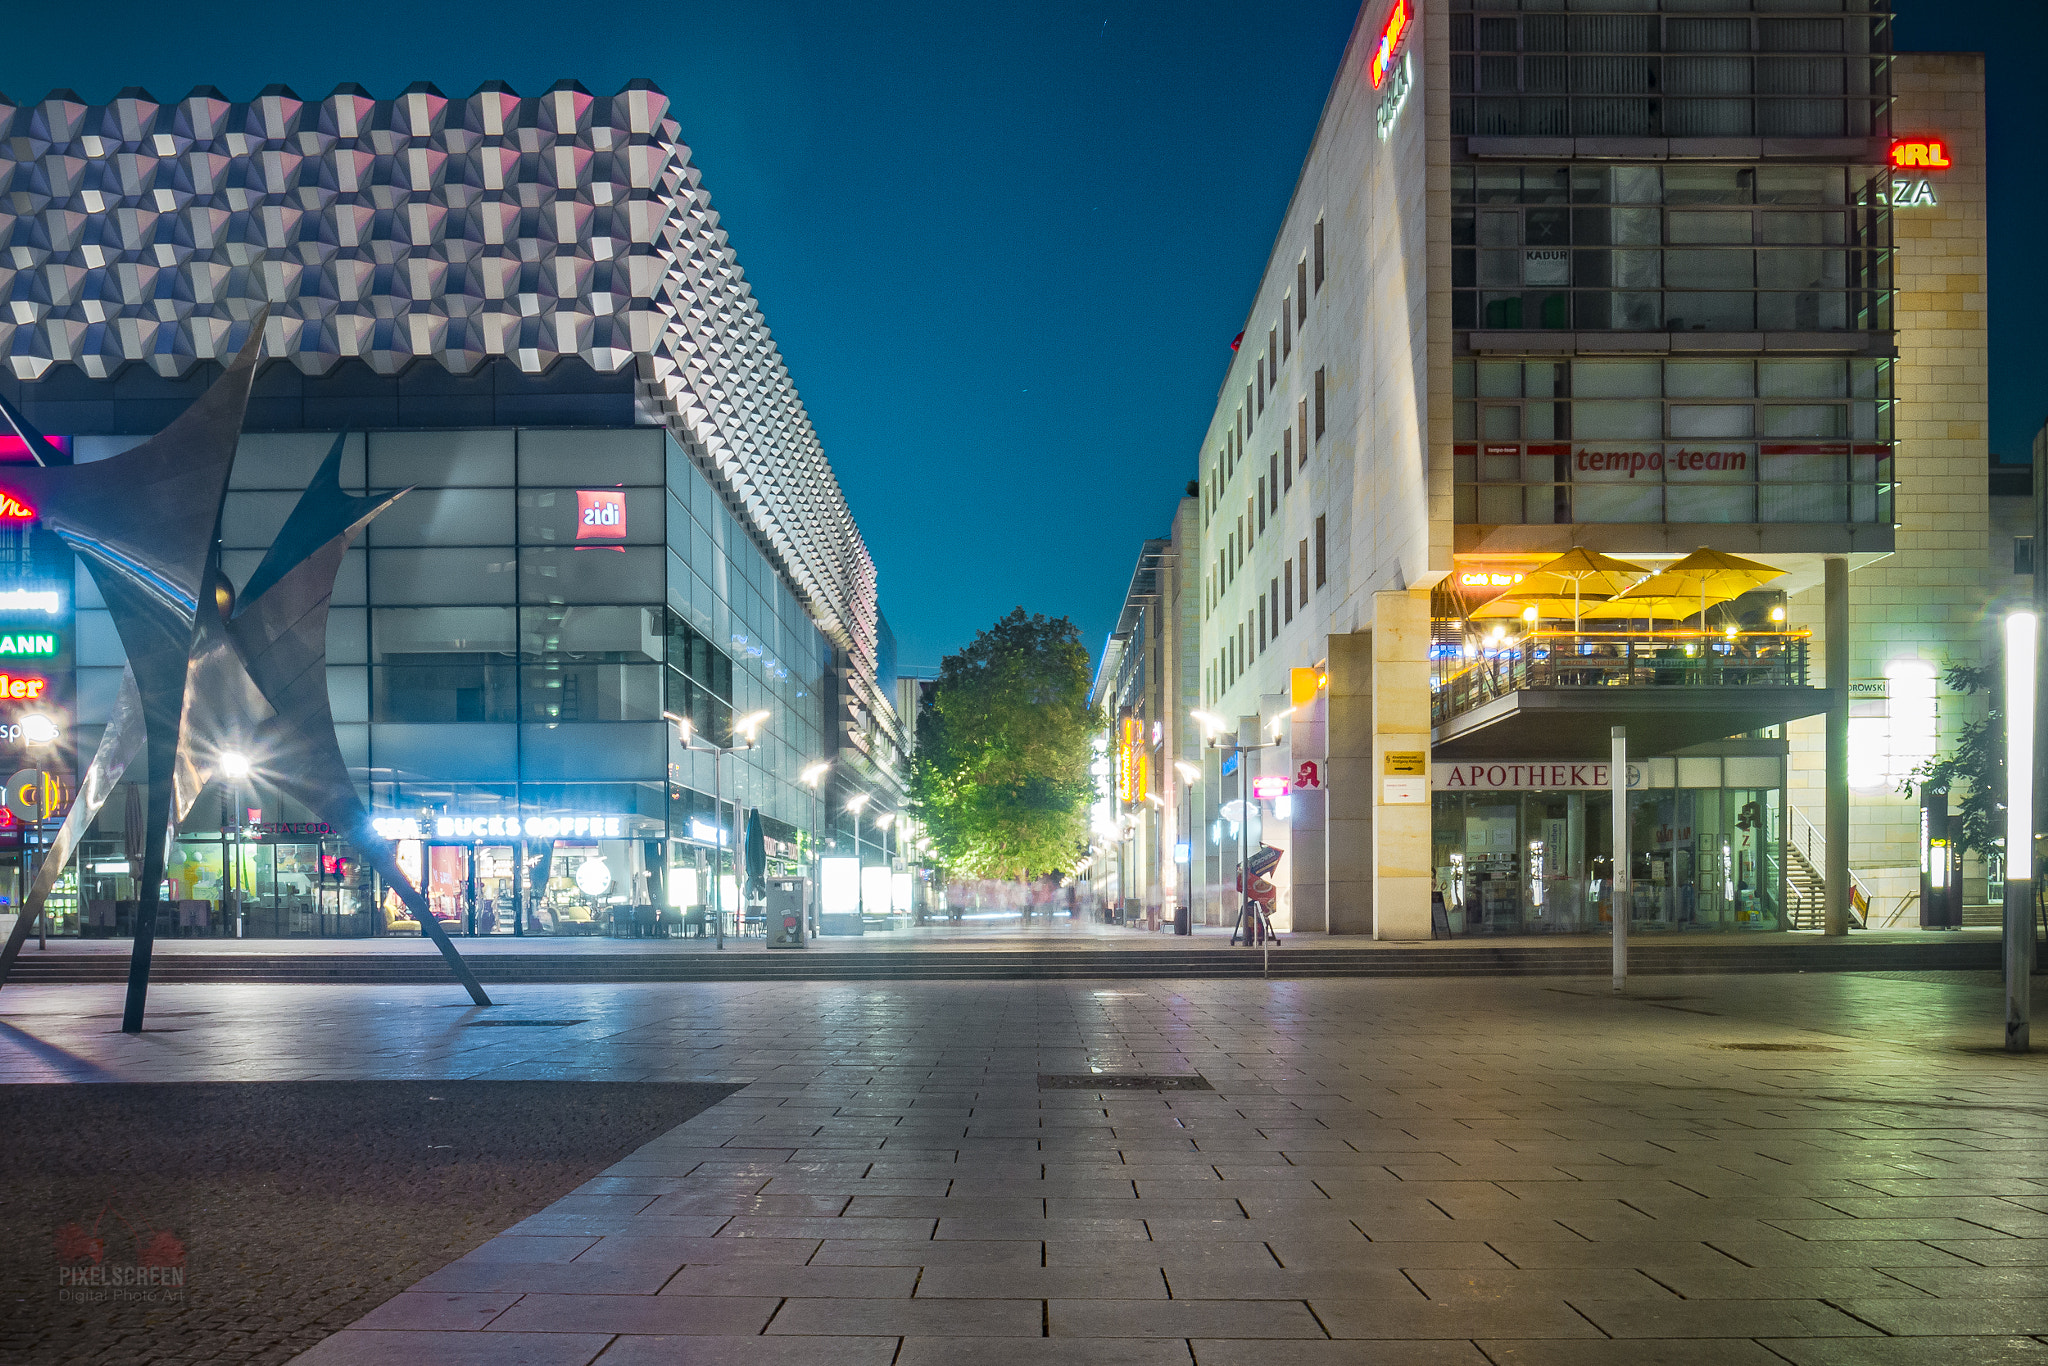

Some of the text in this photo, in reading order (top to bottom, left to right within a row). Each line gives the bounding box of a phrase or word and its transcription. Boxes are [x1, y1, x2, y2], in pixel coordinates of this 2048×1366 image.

[1526, 250, 1568, 261] KADUR
[583, 501, 620, 526] zidi
[1461, 573, 1490, 586] Café
[1490, 573, 1513, 586] Bar
[1447, 765, 1609, 787] APOTHEKE
[524, 817, 621, 838] COFFEE
